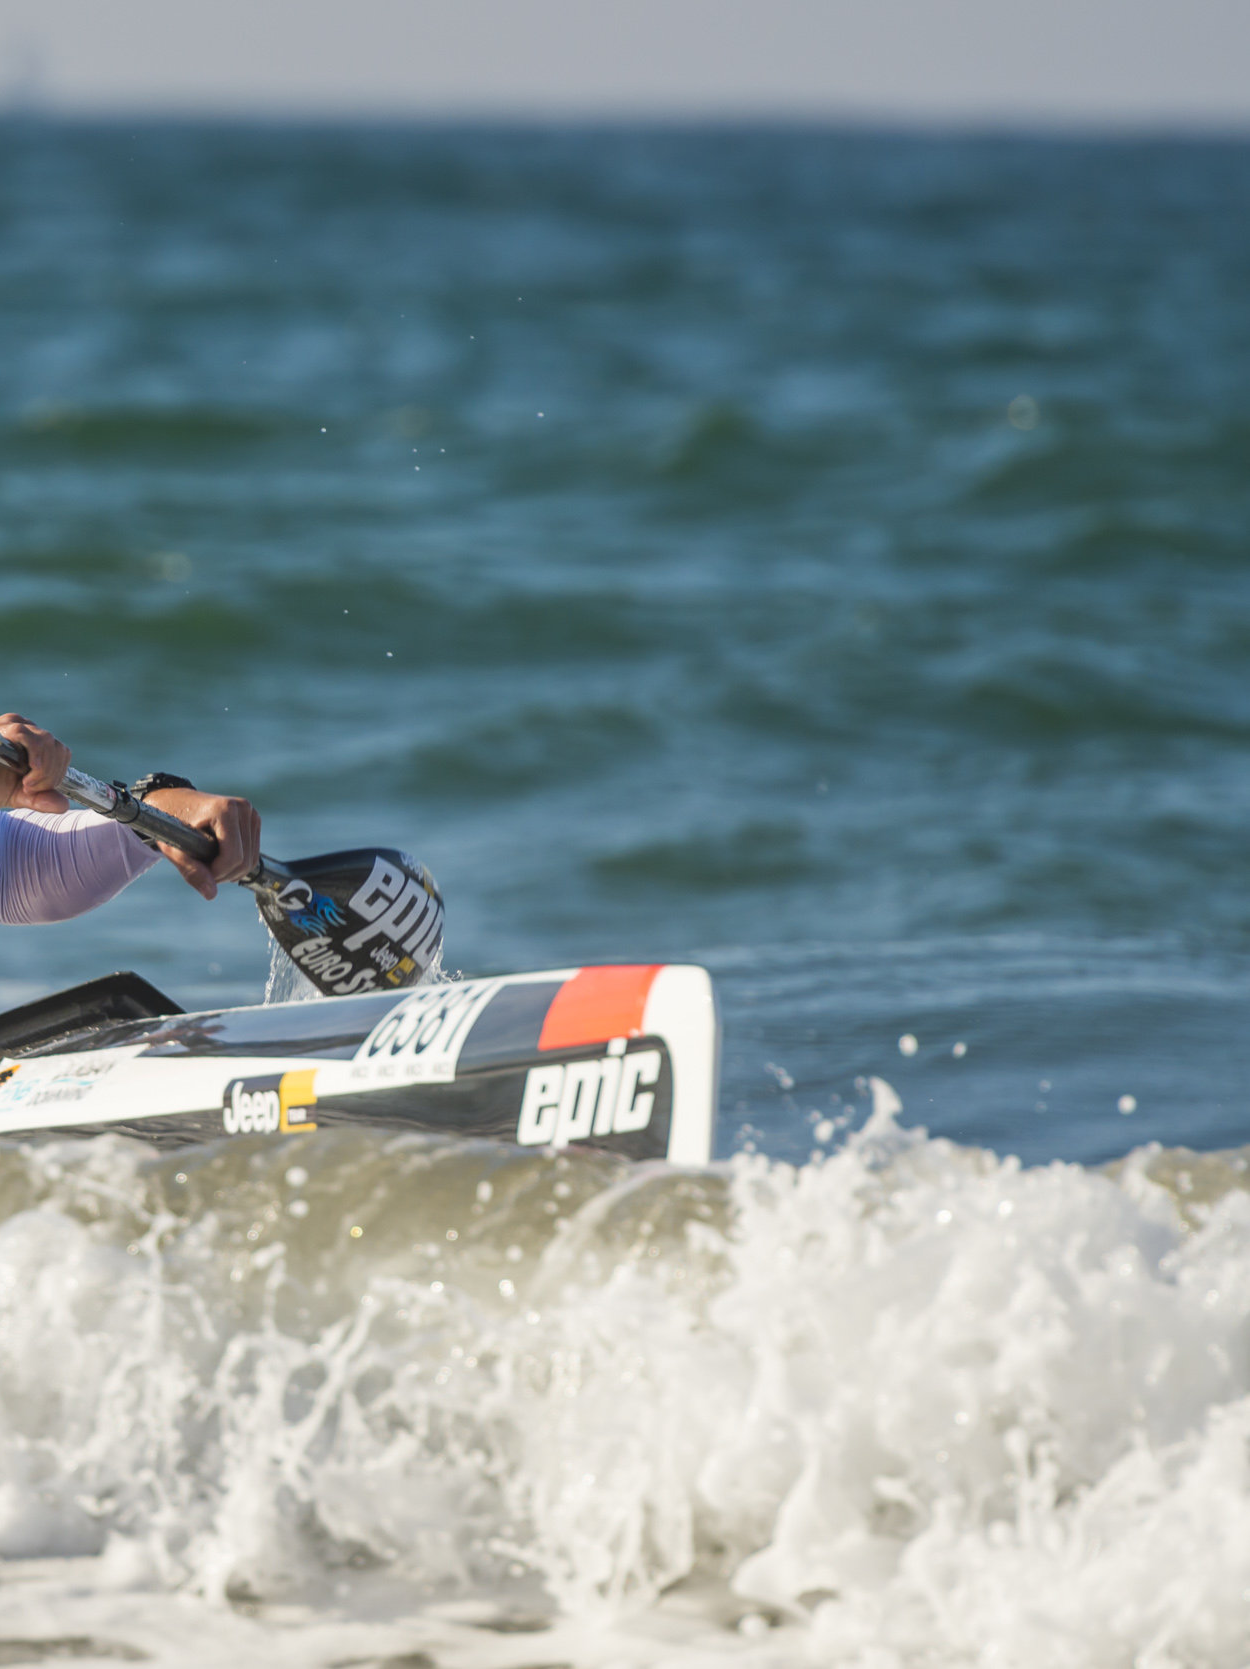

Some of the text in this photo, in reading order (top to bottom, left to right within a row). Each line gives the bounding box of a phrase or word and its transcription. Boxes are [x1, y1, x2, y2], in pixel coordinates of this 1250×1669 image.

[343, 855, 444, 978] epic
[291, 936, 353, 982] EURO
[223, 1081, 279, 1135] Jeep
[517, 1037, 661, 1149] epic
